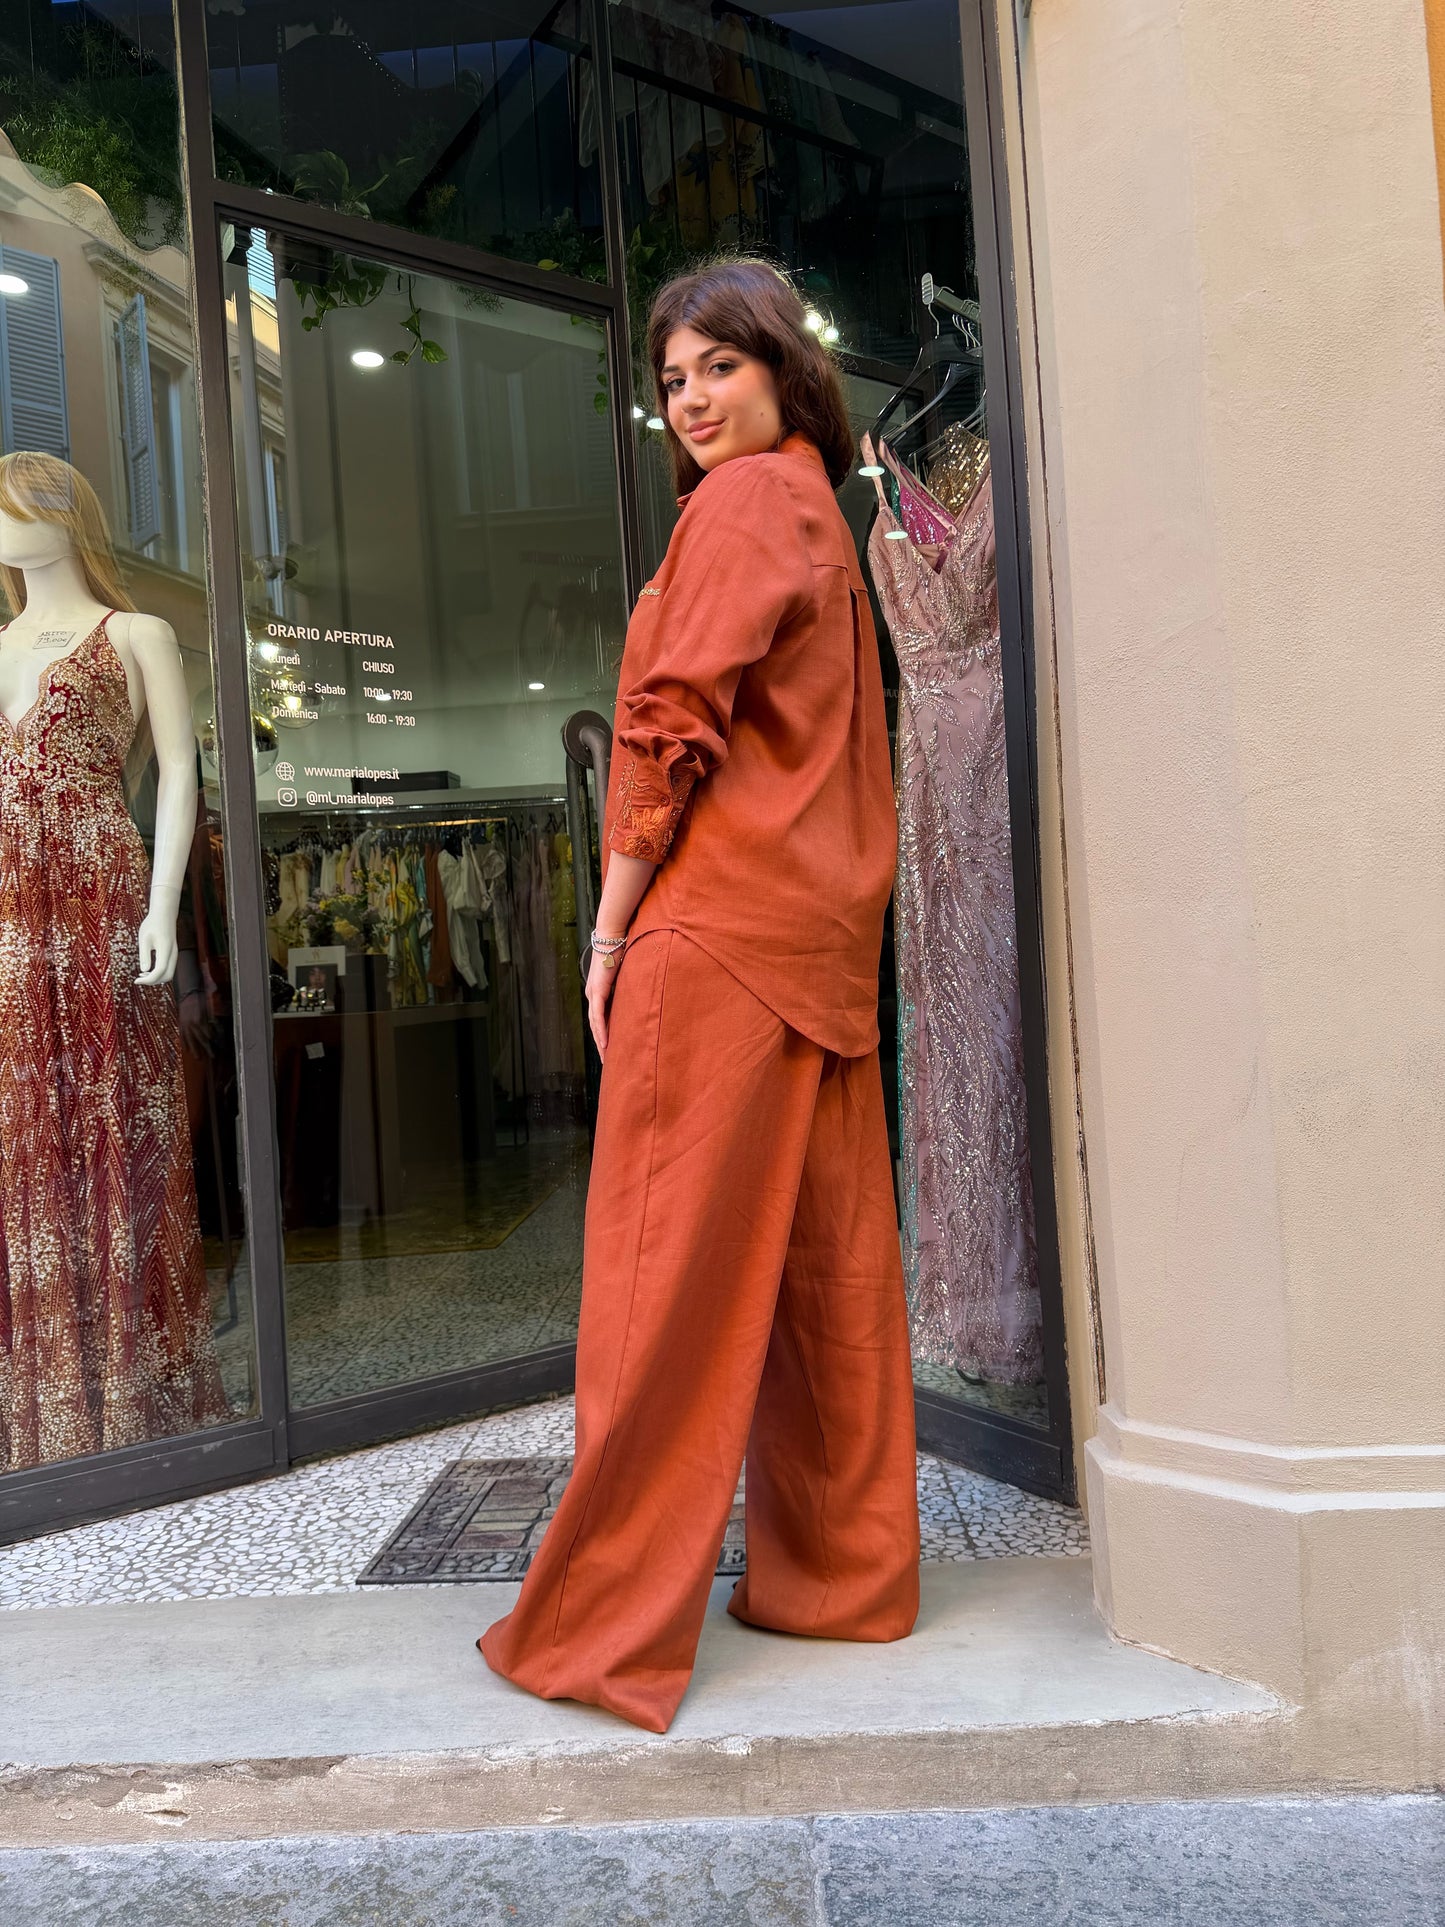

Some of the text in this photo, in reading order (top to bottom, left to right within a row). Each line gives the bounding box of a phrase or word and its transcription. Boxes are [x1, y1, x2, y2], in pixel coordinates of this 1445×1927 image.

[267, 623, 395, 649] ORARIO APERTURA
[270, 652, 395, 674] unedì CHIUSO
[270, 678, 307, 694] Martedì
[314, 682, 346, 696] Sabato
[363, 686, 385, 699] 10:00
[391, 689, 413, 701] 19:30
[271, 705, 319, 720] Domenica
[366, 712, 387, 725] 16:00
[395, 715, 416, 727] 19:30
[304, 766, 400, 782] www.marialopes.it
[306, 790, 394, 808] @ml_marialopes
